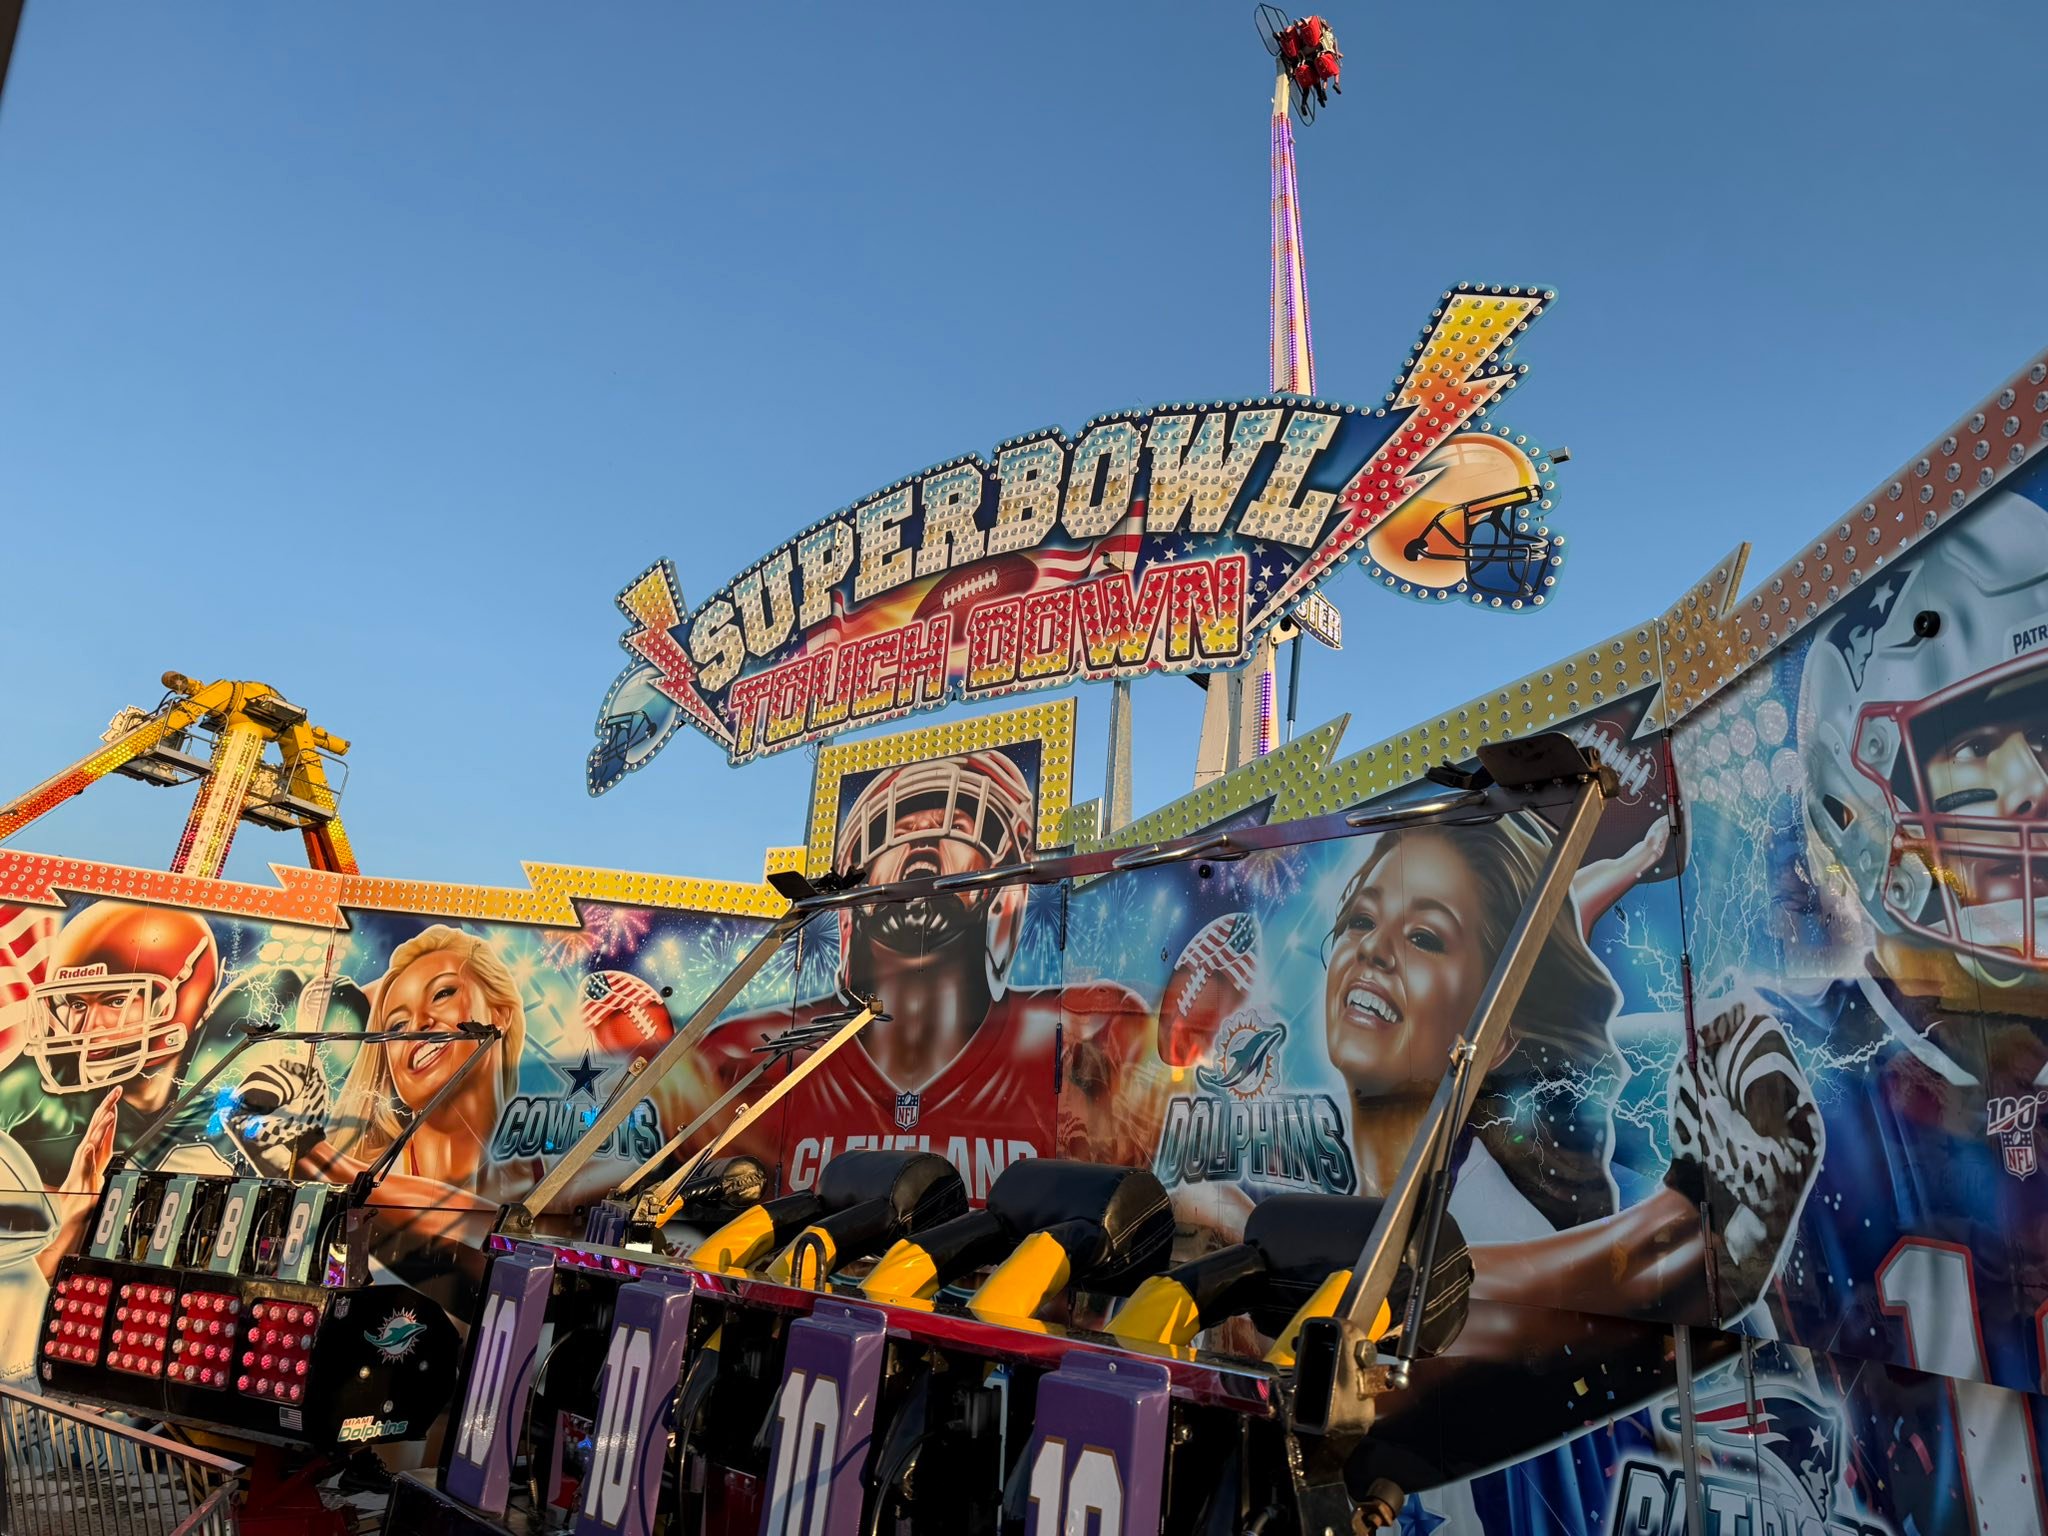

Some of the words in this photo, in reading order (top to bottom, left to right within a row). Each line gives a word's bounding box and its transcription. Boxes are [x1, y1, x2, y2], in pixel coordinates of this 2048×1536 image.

[688, 408, 1341, 692] SUPERBOWL
[728, 613, 952, 757] TOUCH
[965, 555, 1247, 693] DOWN
[59, 966, 103, 979] Riddell
[494, 1098, 664, 1162] COWBYS
[1157, 1095, 1356, 1194] DOLPHINS
[1986, 1094, 2038, 1135] 100
[96, 1187, 122, 1244] 8
[152, 1191, 180, 1250] 8
[216, 1196, 244, 1257] 8
[282, 1202, 310, 1266] 8
[457, 1292, 517, 1470] 10
[337, 1420, 409, 1442] Dolphins
[343, 1416, 374, 1427] MIAMI
[584, 1323, 653, 1529] 10
[767, 1368, 841, 1536] 10
